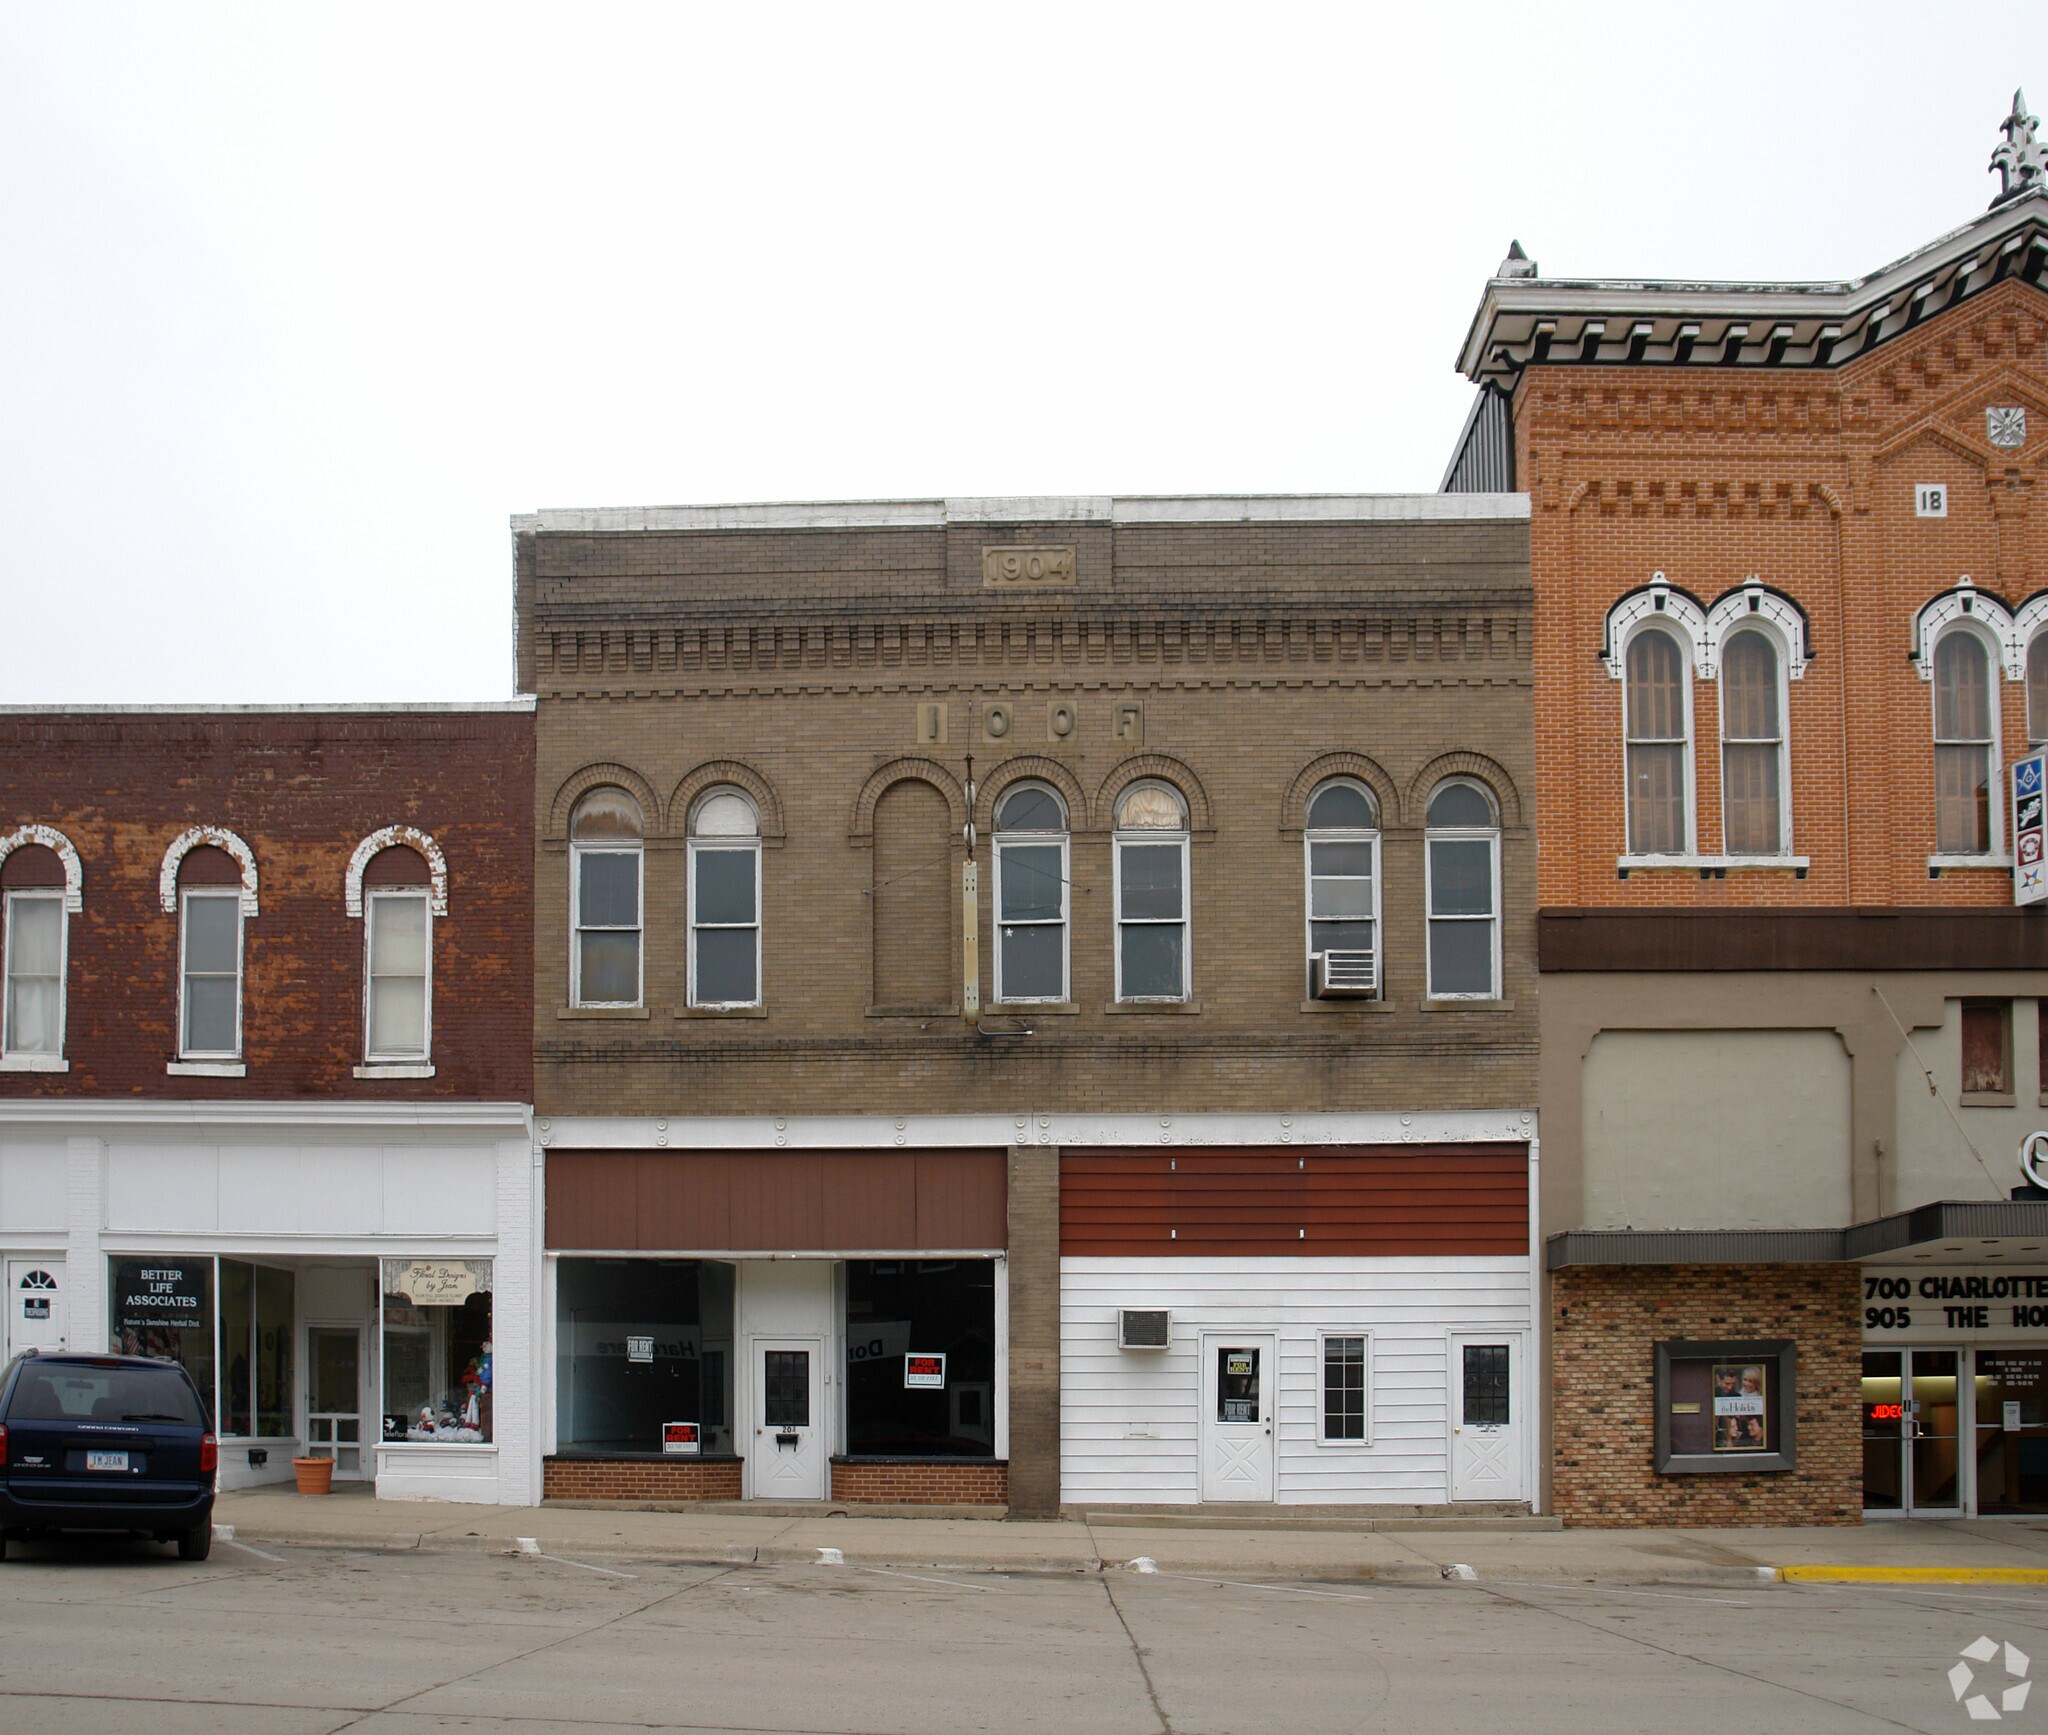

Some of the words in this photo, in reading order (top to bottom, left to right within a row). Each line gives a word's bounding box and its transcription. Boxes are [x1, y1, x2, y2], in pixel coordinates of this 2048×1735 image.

[1922, 490, 1942, 510] 18
[988, 552, 1071, 581] 1904
[141, 1269, 183, 1281] BETTER
[410, 1266, 437, 1280] Floral
[438, 1267, 467, 1283] Designs
[150, 1282, 174, 1294] LIFE
[425, 1280, 436, 1293] by
[436, 1278, 459, 1293] Jean
[1864, 1277, 1911, 1300] 700
[1918, 1276, 2048, 1299] CHARLOTTE
[126, 1295, 197, 1308] ASSOCIATES
[1865, 1306, 1911, 1329] 905
[1943, 1305, 1989, 1328] THE
[628, 1340, 638, 1352] FOR
[639, 1340, 653, 1352] RENT
[915, 1358, 935, 1366] FOR
[909, 1366, 941, 1374] RENT
[1224, 1402, 1235, 1415] FOR
[1237, 1402, 1251, 1415] RENT
[671, 1426, 691, 1434] FOR
[666, 1434, 697, 1442] RENT
